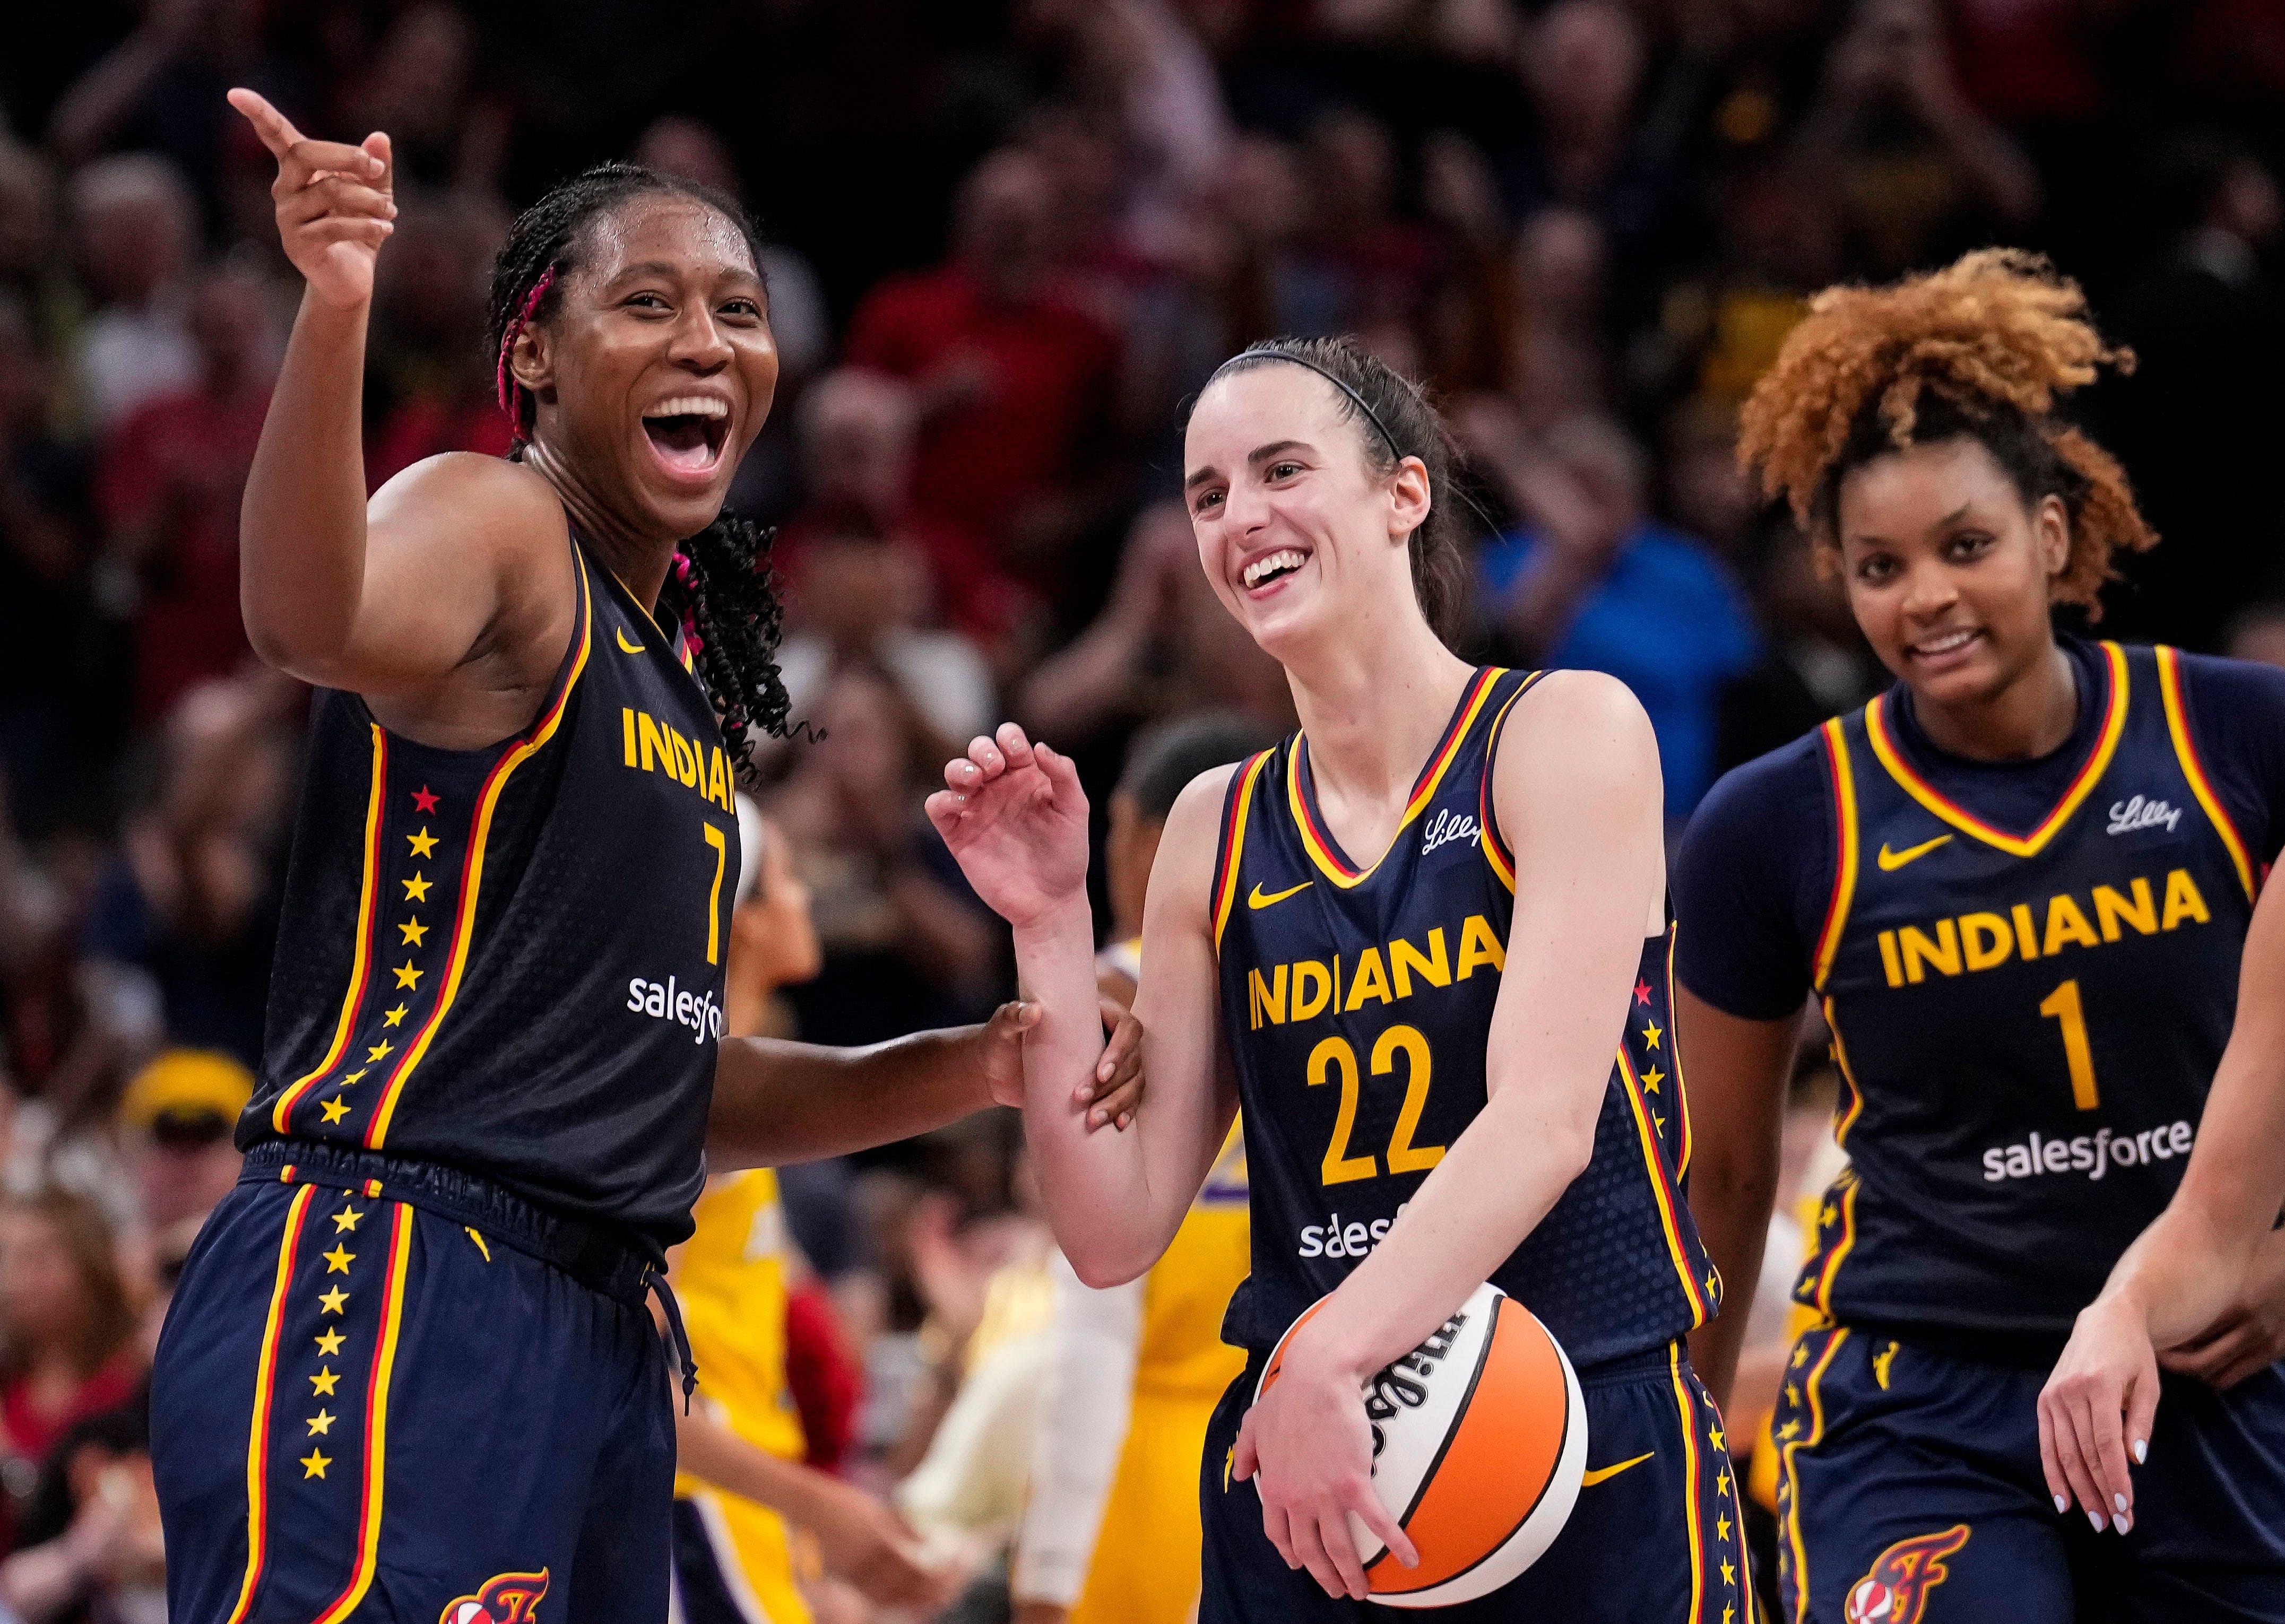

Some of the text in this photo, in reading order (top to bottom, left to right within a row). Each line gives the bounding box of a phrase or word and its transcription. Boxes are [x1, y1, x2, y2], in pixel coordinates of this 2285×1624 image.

[1422, 807, 1482, 856] Lilly
[2106, 794, 2183, 836] Lilly
[703, 821, 726, 967] 7
[1877, 867, 2212, 989] INDIANA
[1248, 914, 1506, 1031] INDIANA
[2039, 978, 2101, 1112] 1
[1306, 1023, 1447, 1187] 22
[1983, 1120, 2194, 1181] salesforce
[1298, 1202, 1409, 1258] sales
